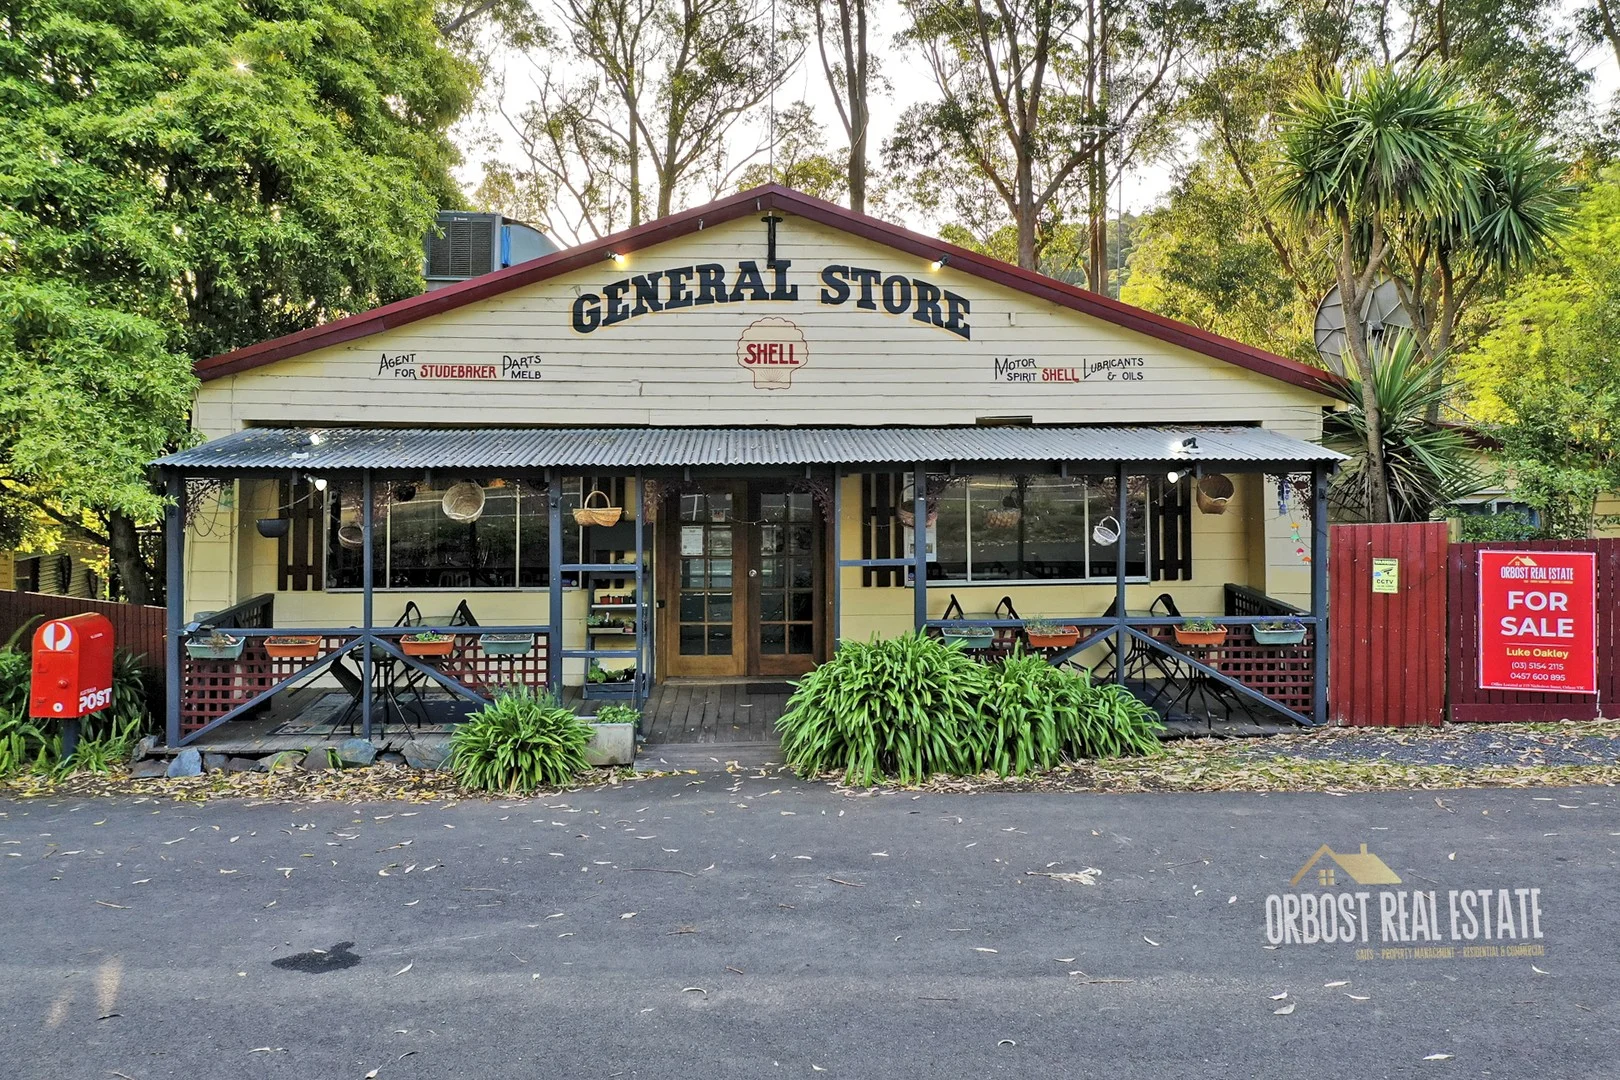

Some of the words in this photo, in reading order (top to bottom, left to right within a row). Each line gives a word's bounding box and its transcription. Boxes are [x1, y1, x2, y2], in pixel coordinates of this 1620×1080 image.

[572, 260, 798, 334] GENERAL
[820, 264, 971, 341] STORE
[378, 353, 416, 376] AGENT
[502, 355, 541, 377] PARTS
[743, 343, 799, 365] SHELL
[394, 368, 417, 380] FOR
[420, 364, 497, 379] STUDEBAKER
[511, 370, 541, 379] MELB
[995, 357, 1037, 380] MOTOR
[1083, 358, 1144, 380] LUBRICANTS
[1006, 372, 1037, 383] SPIRIT
[1042, 368, 1079, 383] SHELL
[1122, 372, 1144, 381] OILS
[1500, 566, 1529, 579] ORBOST
[1530, 567, 1547, 580] REAL
[1548, 567, 1574, 581] ESTATE
[1507, 590, 1568, 612] FOR
[1500, 616, 1575, 638] SALE
[1506, 647, 1531, 656] Luke
[1532, 648, 1569, 660] Oakley
[1510, 672, 1531, 680] 0457
[1532, 673, 1549, 681] 600
[1550, 673, 1566, 681] 895
[1511, 661, 1527, 670] (03)
[1528, 662, 1547, 670] 5154
[79, 687, 112, 713] POST
